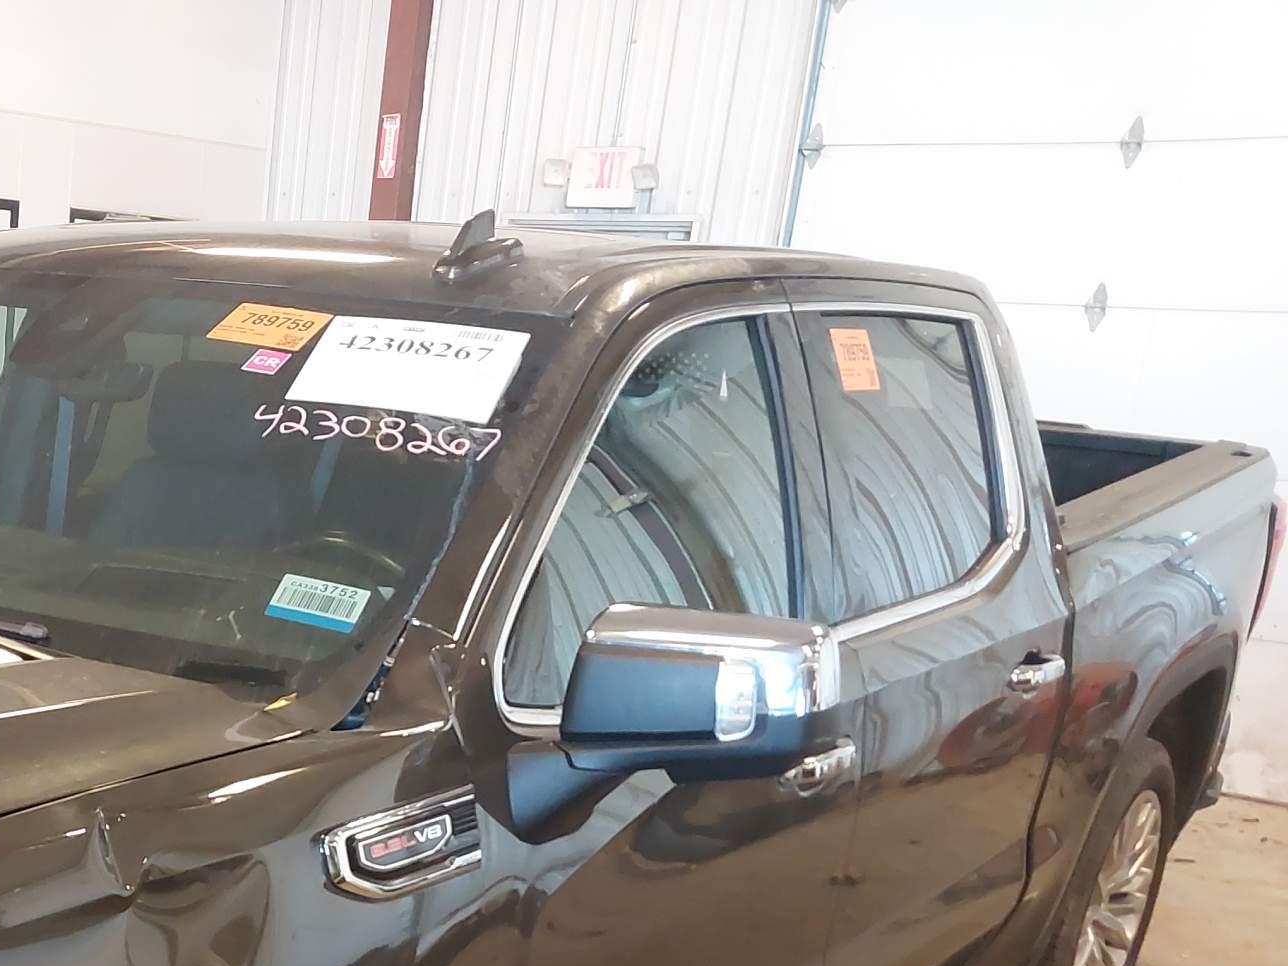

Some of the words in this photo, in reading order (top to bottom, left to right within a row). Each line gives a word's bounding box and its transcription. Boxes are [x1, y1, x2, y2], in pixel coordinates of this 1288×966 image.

[241, 312, 315, 332] 789759
[339, 334, 494, 362] 42308267
[253, 355, 281, 368] CR
[254, 404, 502, 462] 42308267
[414, 824, 443, 843] V8
